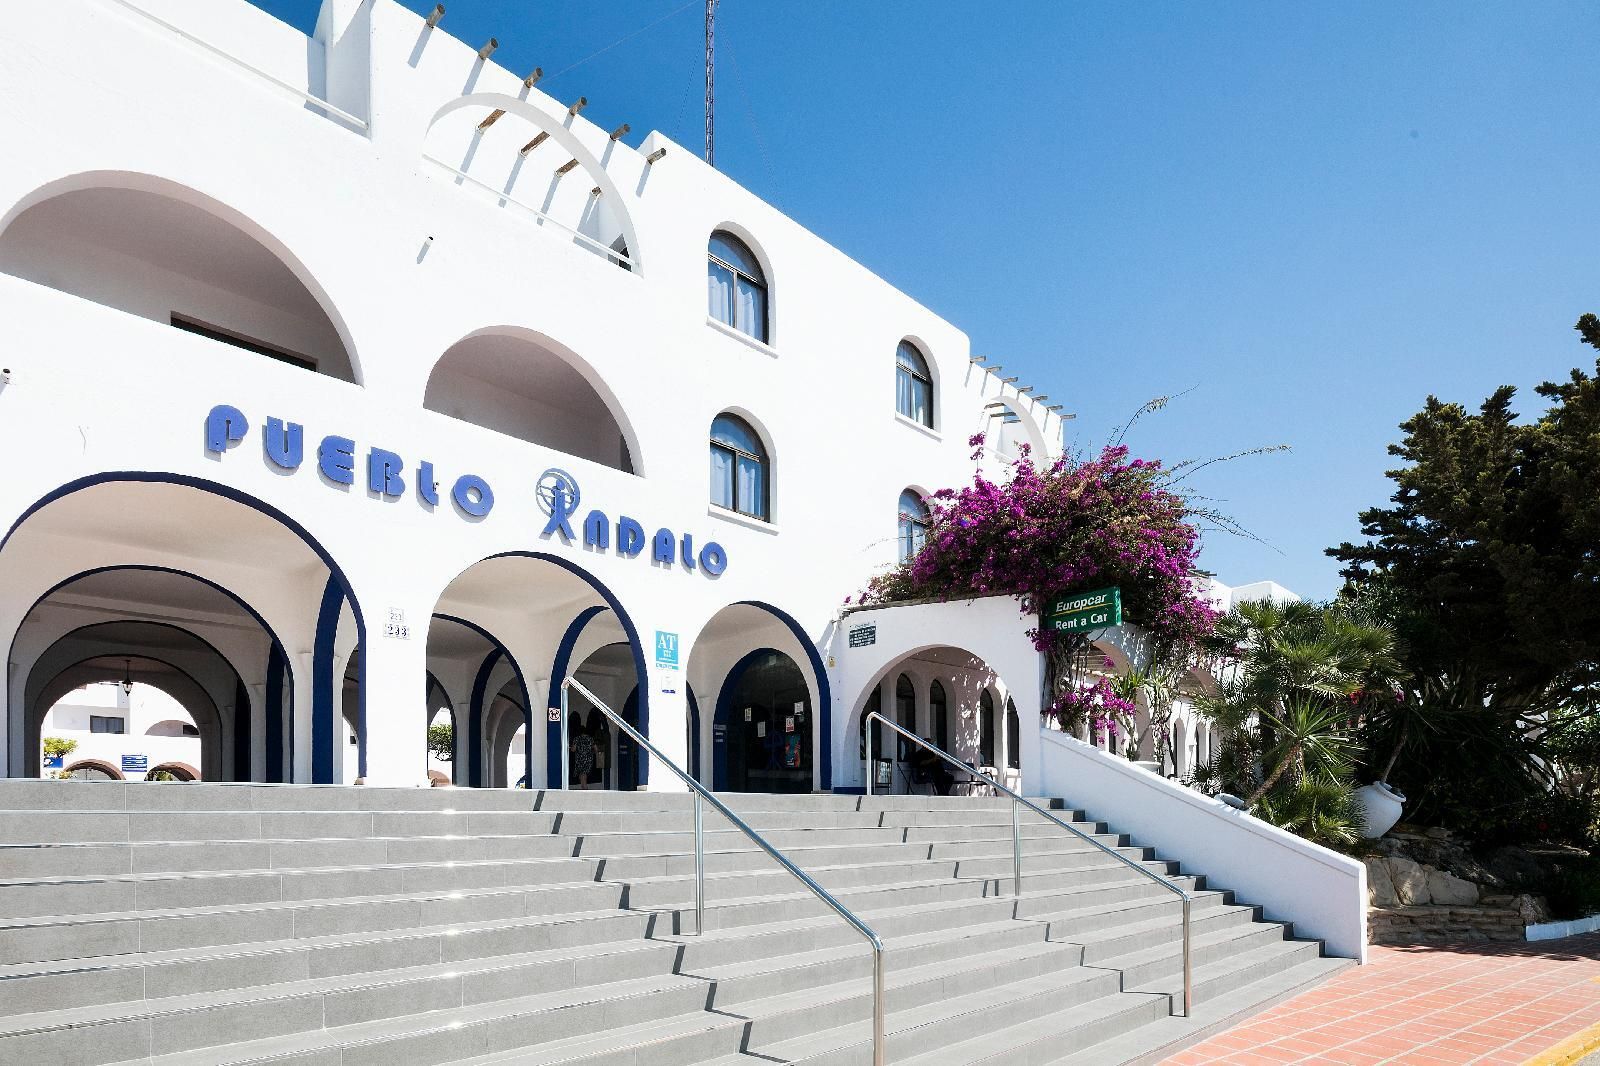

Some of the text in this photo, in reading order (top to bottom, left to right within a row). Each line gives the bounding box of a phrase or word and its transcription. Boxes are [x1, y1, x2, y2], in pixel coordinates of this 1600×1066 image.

[206, 404, 495, 516] PUEBLO
[1055, 593, 1108, 613] Europcar
[1055, 612, 1108, 630] Rent a Car
